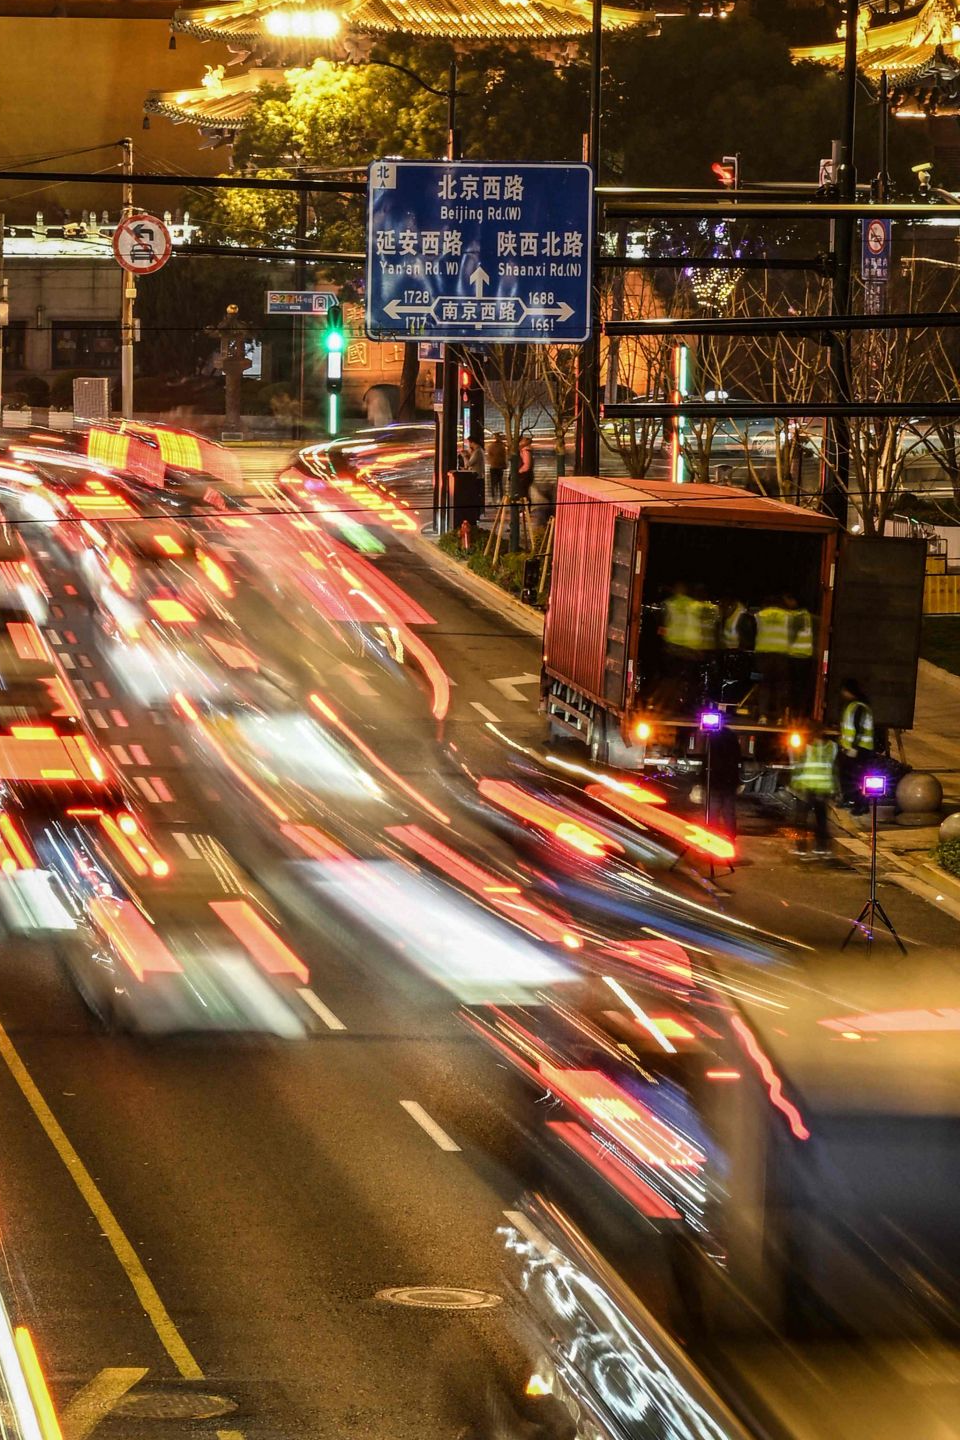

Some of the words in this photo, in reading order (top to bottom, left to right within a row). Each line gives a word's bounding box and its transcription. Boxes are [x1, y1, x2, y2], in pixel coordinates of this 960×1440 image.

[377, 166, 389, 179] 北
[438, 174, 524, 201] 北京西路
[440, 206, 483, 224] Beijing
[488, 206, 521, 221] Rd.(W)
[376, 230, 463, 256] 延安西路
[497, 231, 584, 257] 陕西北路
[380, 261, 420, 275] Yan'an
[498, 263, 546, 277] Shaanxi
[550, 263, 582, 277] Rd.(N)
[404, 290, 430, 304] 1728
[528, 292, 554, 305] 1688
[442, 301, 516, 321] 南京西路
[405, 316, 427, 330] 1717
[531, 318, 554, 331] 1661
